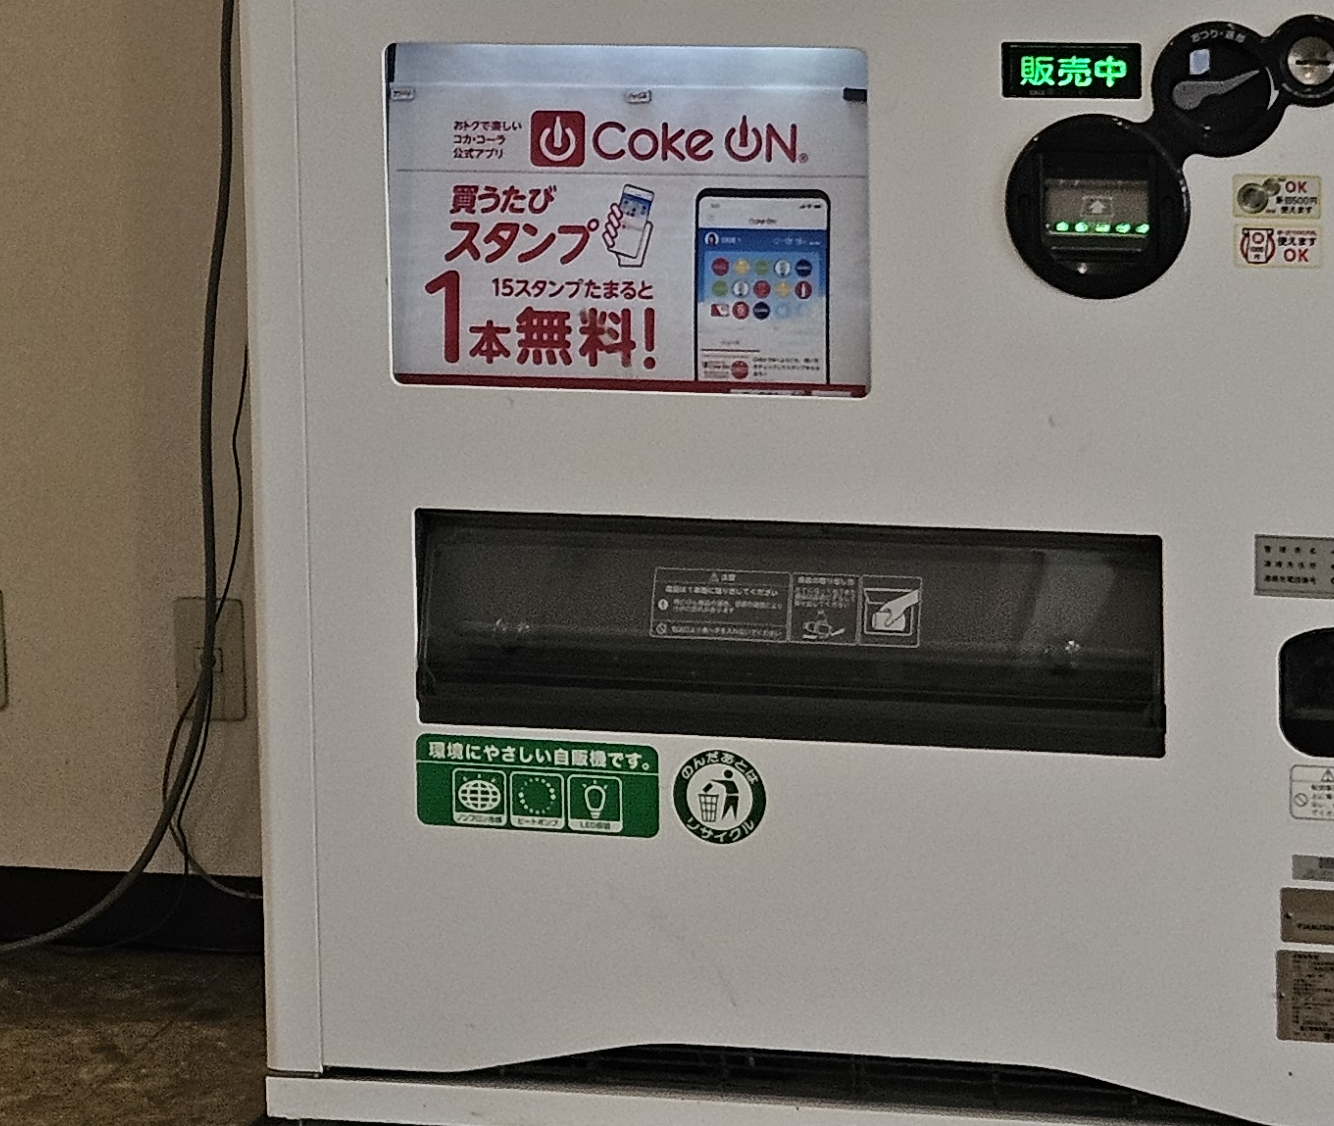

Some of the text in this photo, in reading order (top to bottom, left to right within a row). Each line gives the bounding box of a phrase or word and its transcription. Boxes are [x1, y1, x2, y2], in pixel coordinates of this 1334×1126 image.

[1020, 55, 1127, 88] 販売中
[453, 120, 522, 131] おトクで楽しい
[453, 134, 506, 145] コカ・コーラ
[592, 120, 714, 163] Coke
[453, 148, 504, 159] 公式アプリ
[1285, 181, 1308, 193] OK
[450, 184, 557, 215] 買うたび
[445, 219, 599, 264] スタンプ
[1278, 237, 1317, 246] 使えます
[1283, 248, 1309, 262] OK
[492, 278, 655, 300] 15スタンプたまると
[428, 741, 651, 771] 環境にやさしい自販機です。
[681, 752, 760, 785] のんだあとは
[686, 816, 756, 843] リサイクル
